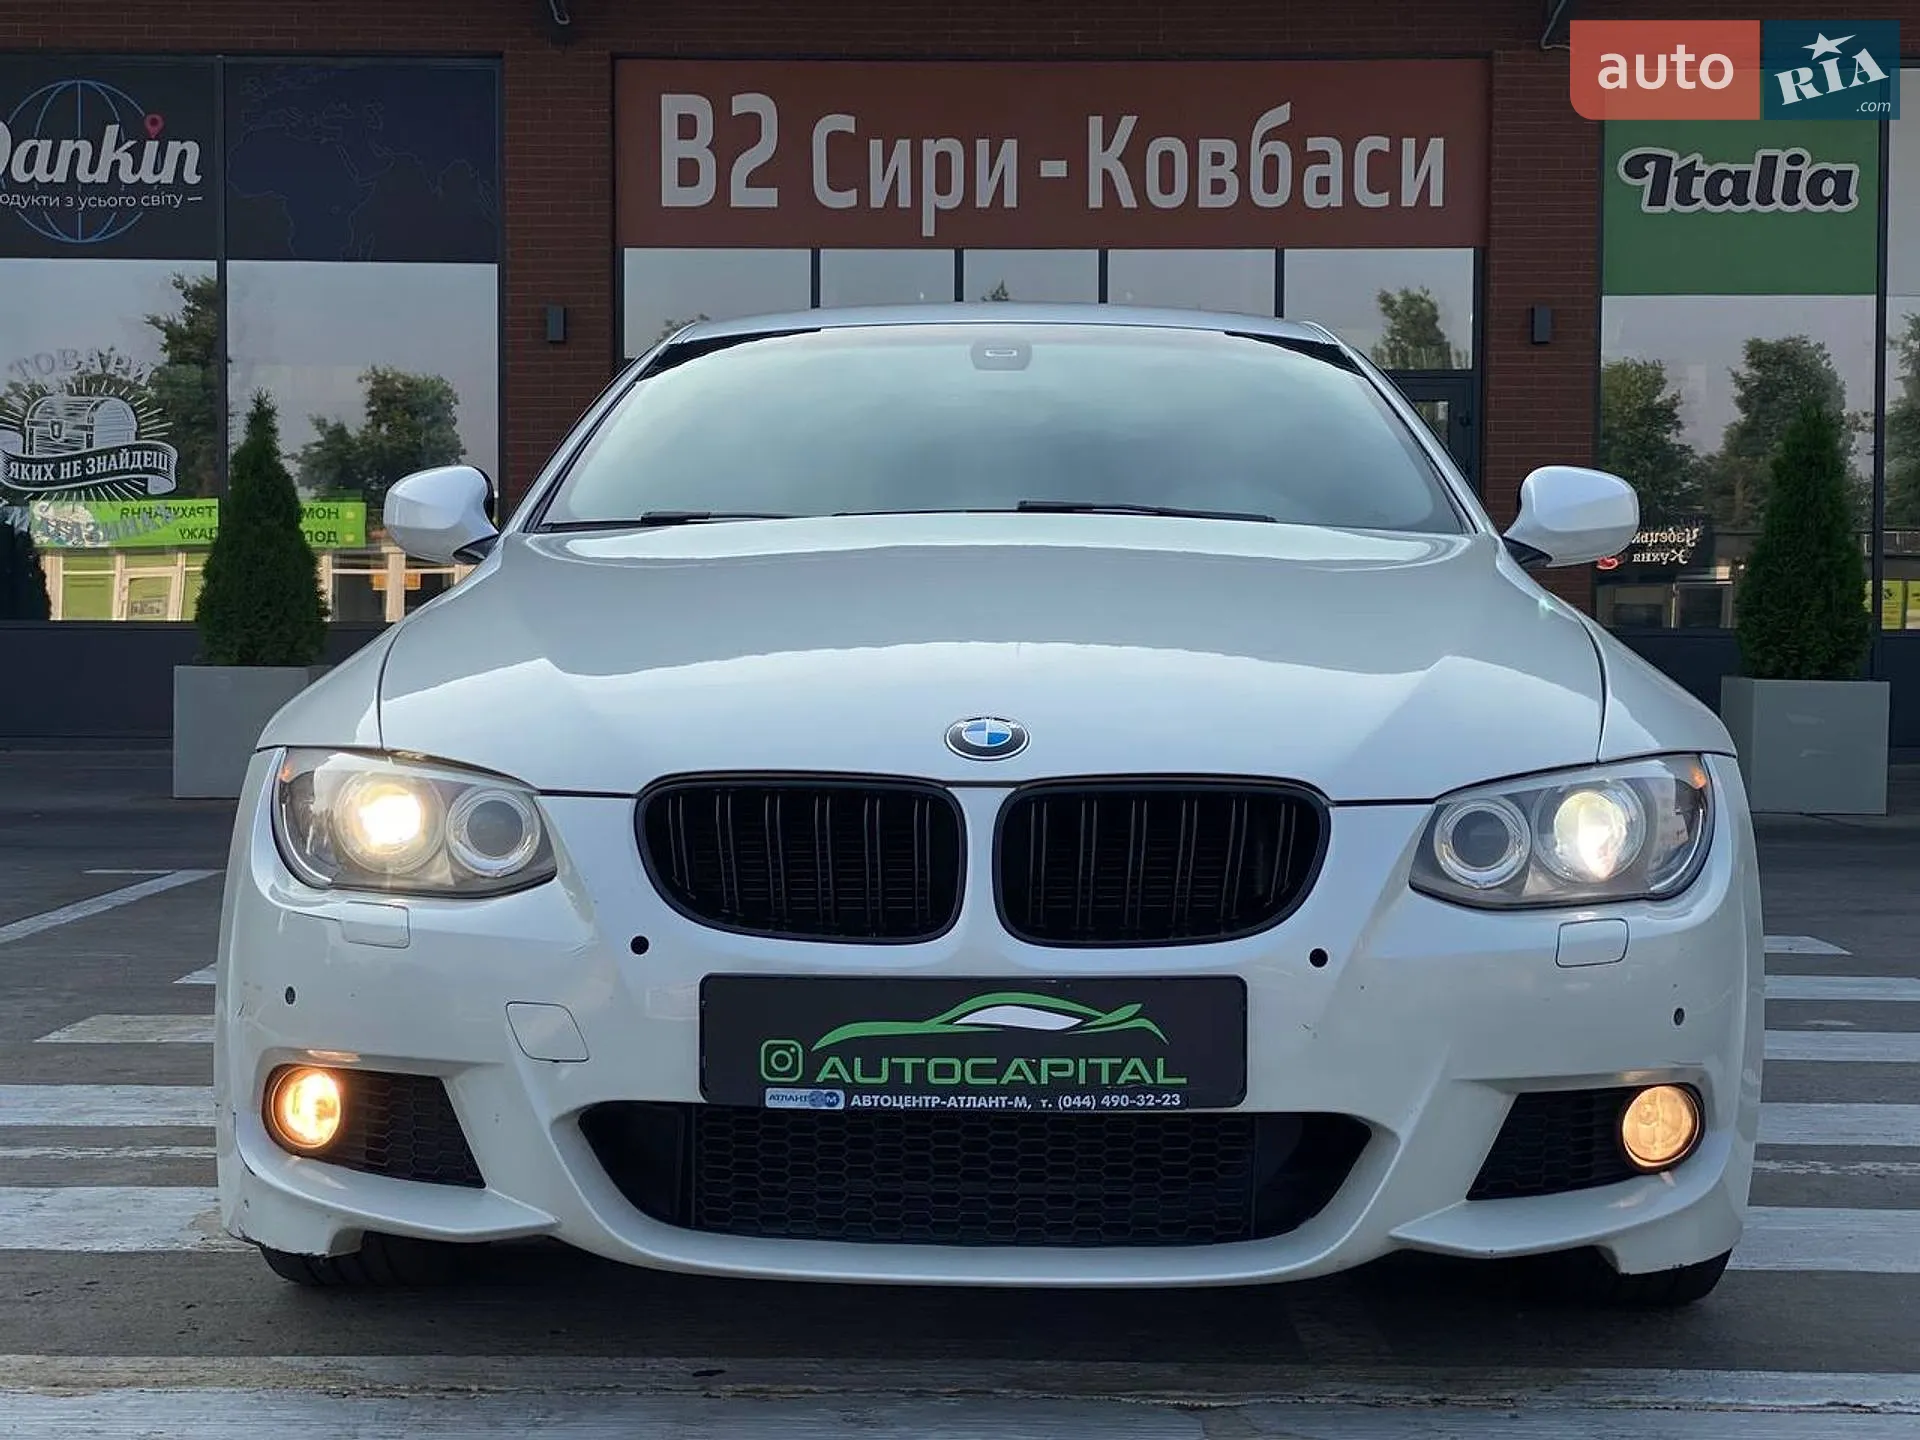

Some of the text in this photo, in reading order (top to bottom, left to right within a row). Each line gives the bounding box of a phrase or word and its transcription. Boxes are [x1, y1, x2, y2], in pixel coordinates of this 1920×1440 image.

[0, 121, 202, 185] ankin
[811, 113, 1018, 238] Сири
[1088, 101, 1446, 209] Ковбаси
[1617, 147, 1860, 213] Italia
[0, 193, 60, 209] одукти
[78, 196, 136, 211] усього
[141, 191, 183, 209] світу
[8, 460, 55, 481] ЯКИХ
[59, 459, 83, 479] НЕ
[815, 1056, 1188, 1085] AUTOCAPITAL
[1058, 1095, 1096, 1111] (044)
[1101, 1094, 1181, 1108] 490-32-23
